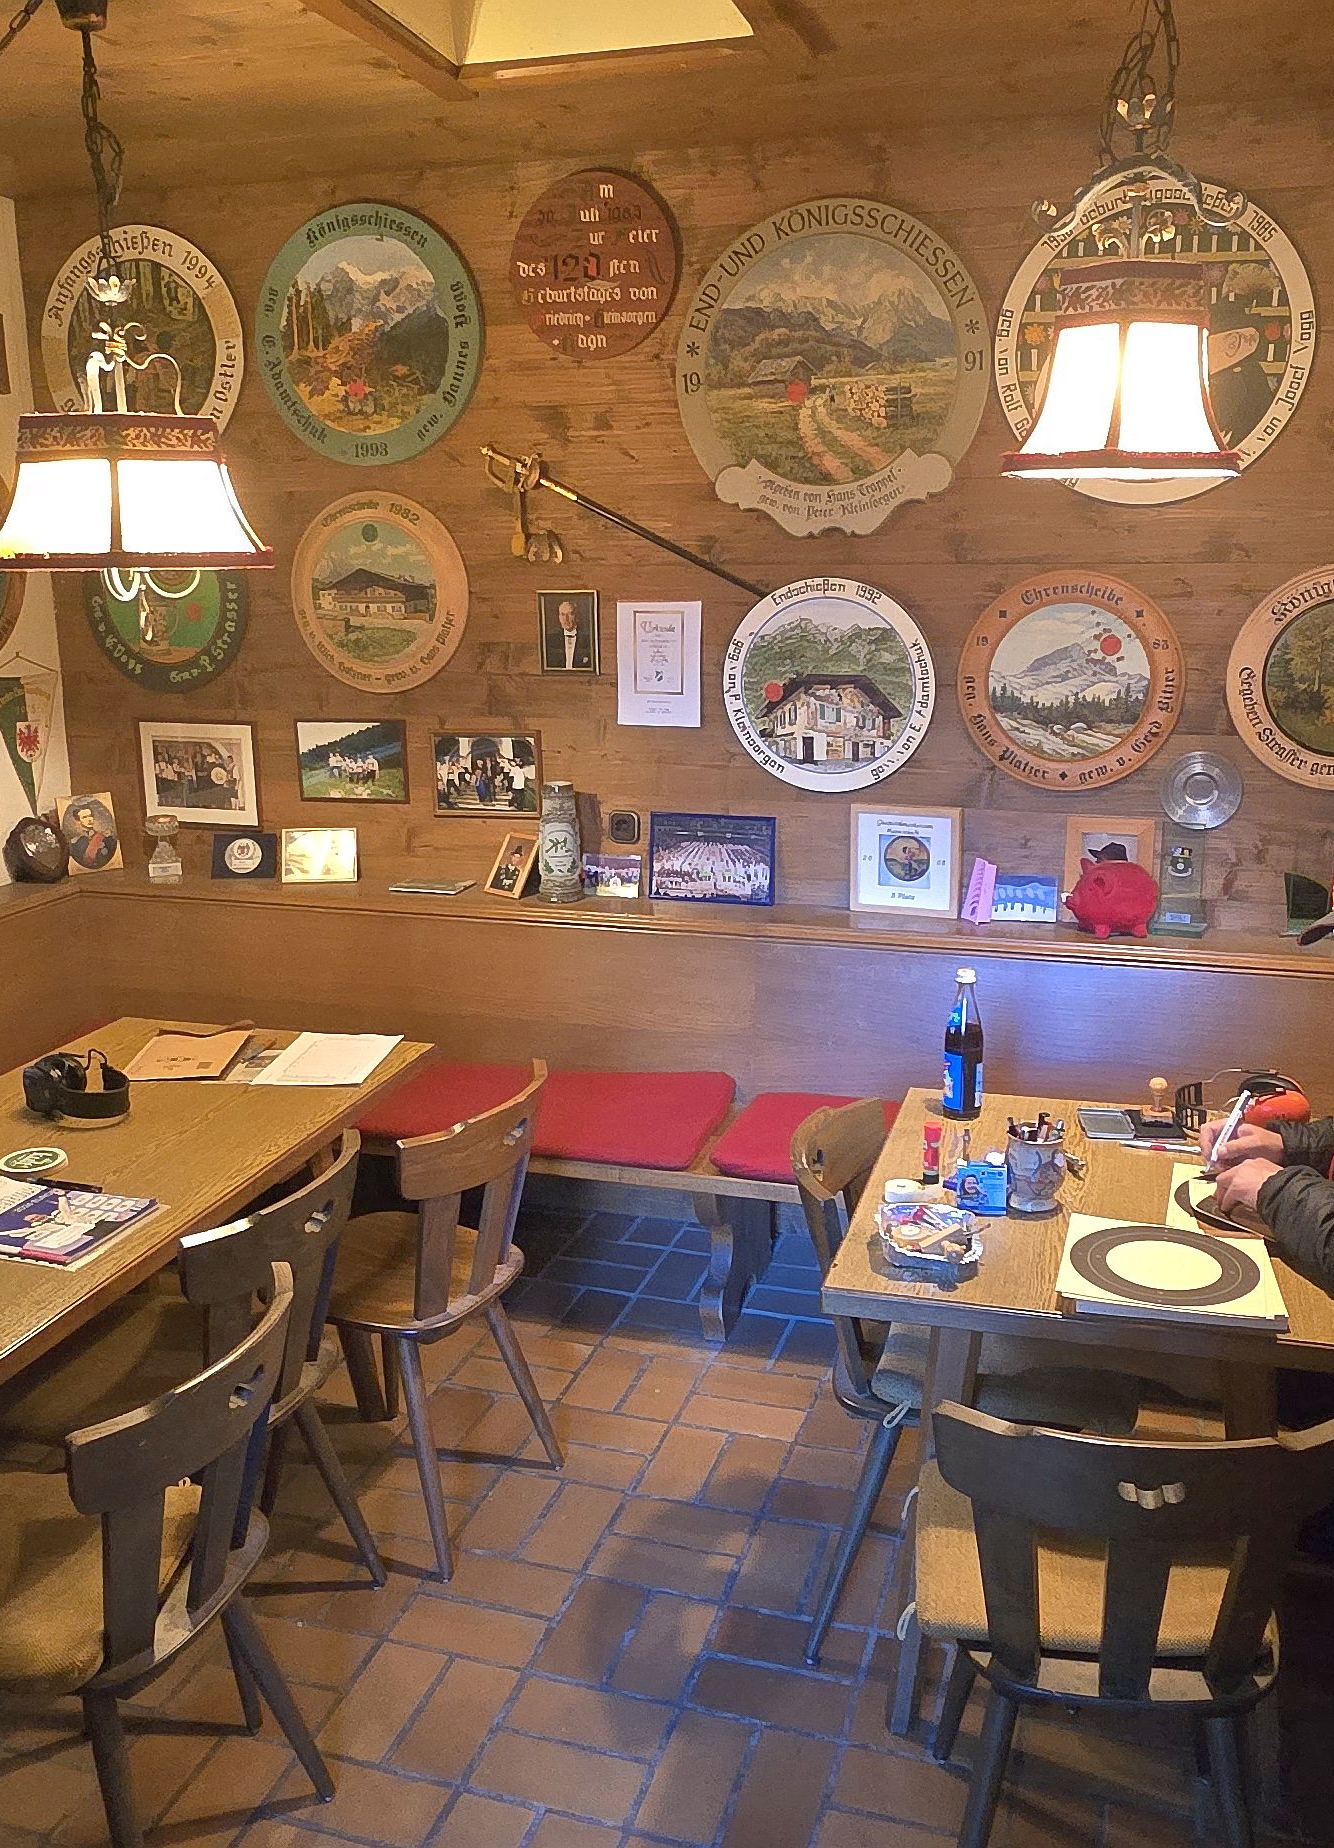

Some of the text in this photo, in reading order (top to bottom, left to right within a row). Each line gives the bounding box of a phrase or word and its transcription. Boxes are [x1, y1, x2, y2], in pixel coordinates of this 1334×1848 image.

[1246, 209, 1276, 243] 1985
[180, 250, 217, 291] 1994
[517, 260, 546, 277] des
[689, 203, 975, 333] END-UND KÖNIGSSCHIESSEN
[629, 286, 658, 301] von
[964, 351, 985, 373] 91
[442, 340, 470, 429] Hannes
[681, 371, 702, 395] 19
[387, 502, 421, 527] 1982
[854, 583, 883, 606] 1992
[1020, 581, 1125, 607] Ehrenscheibe
